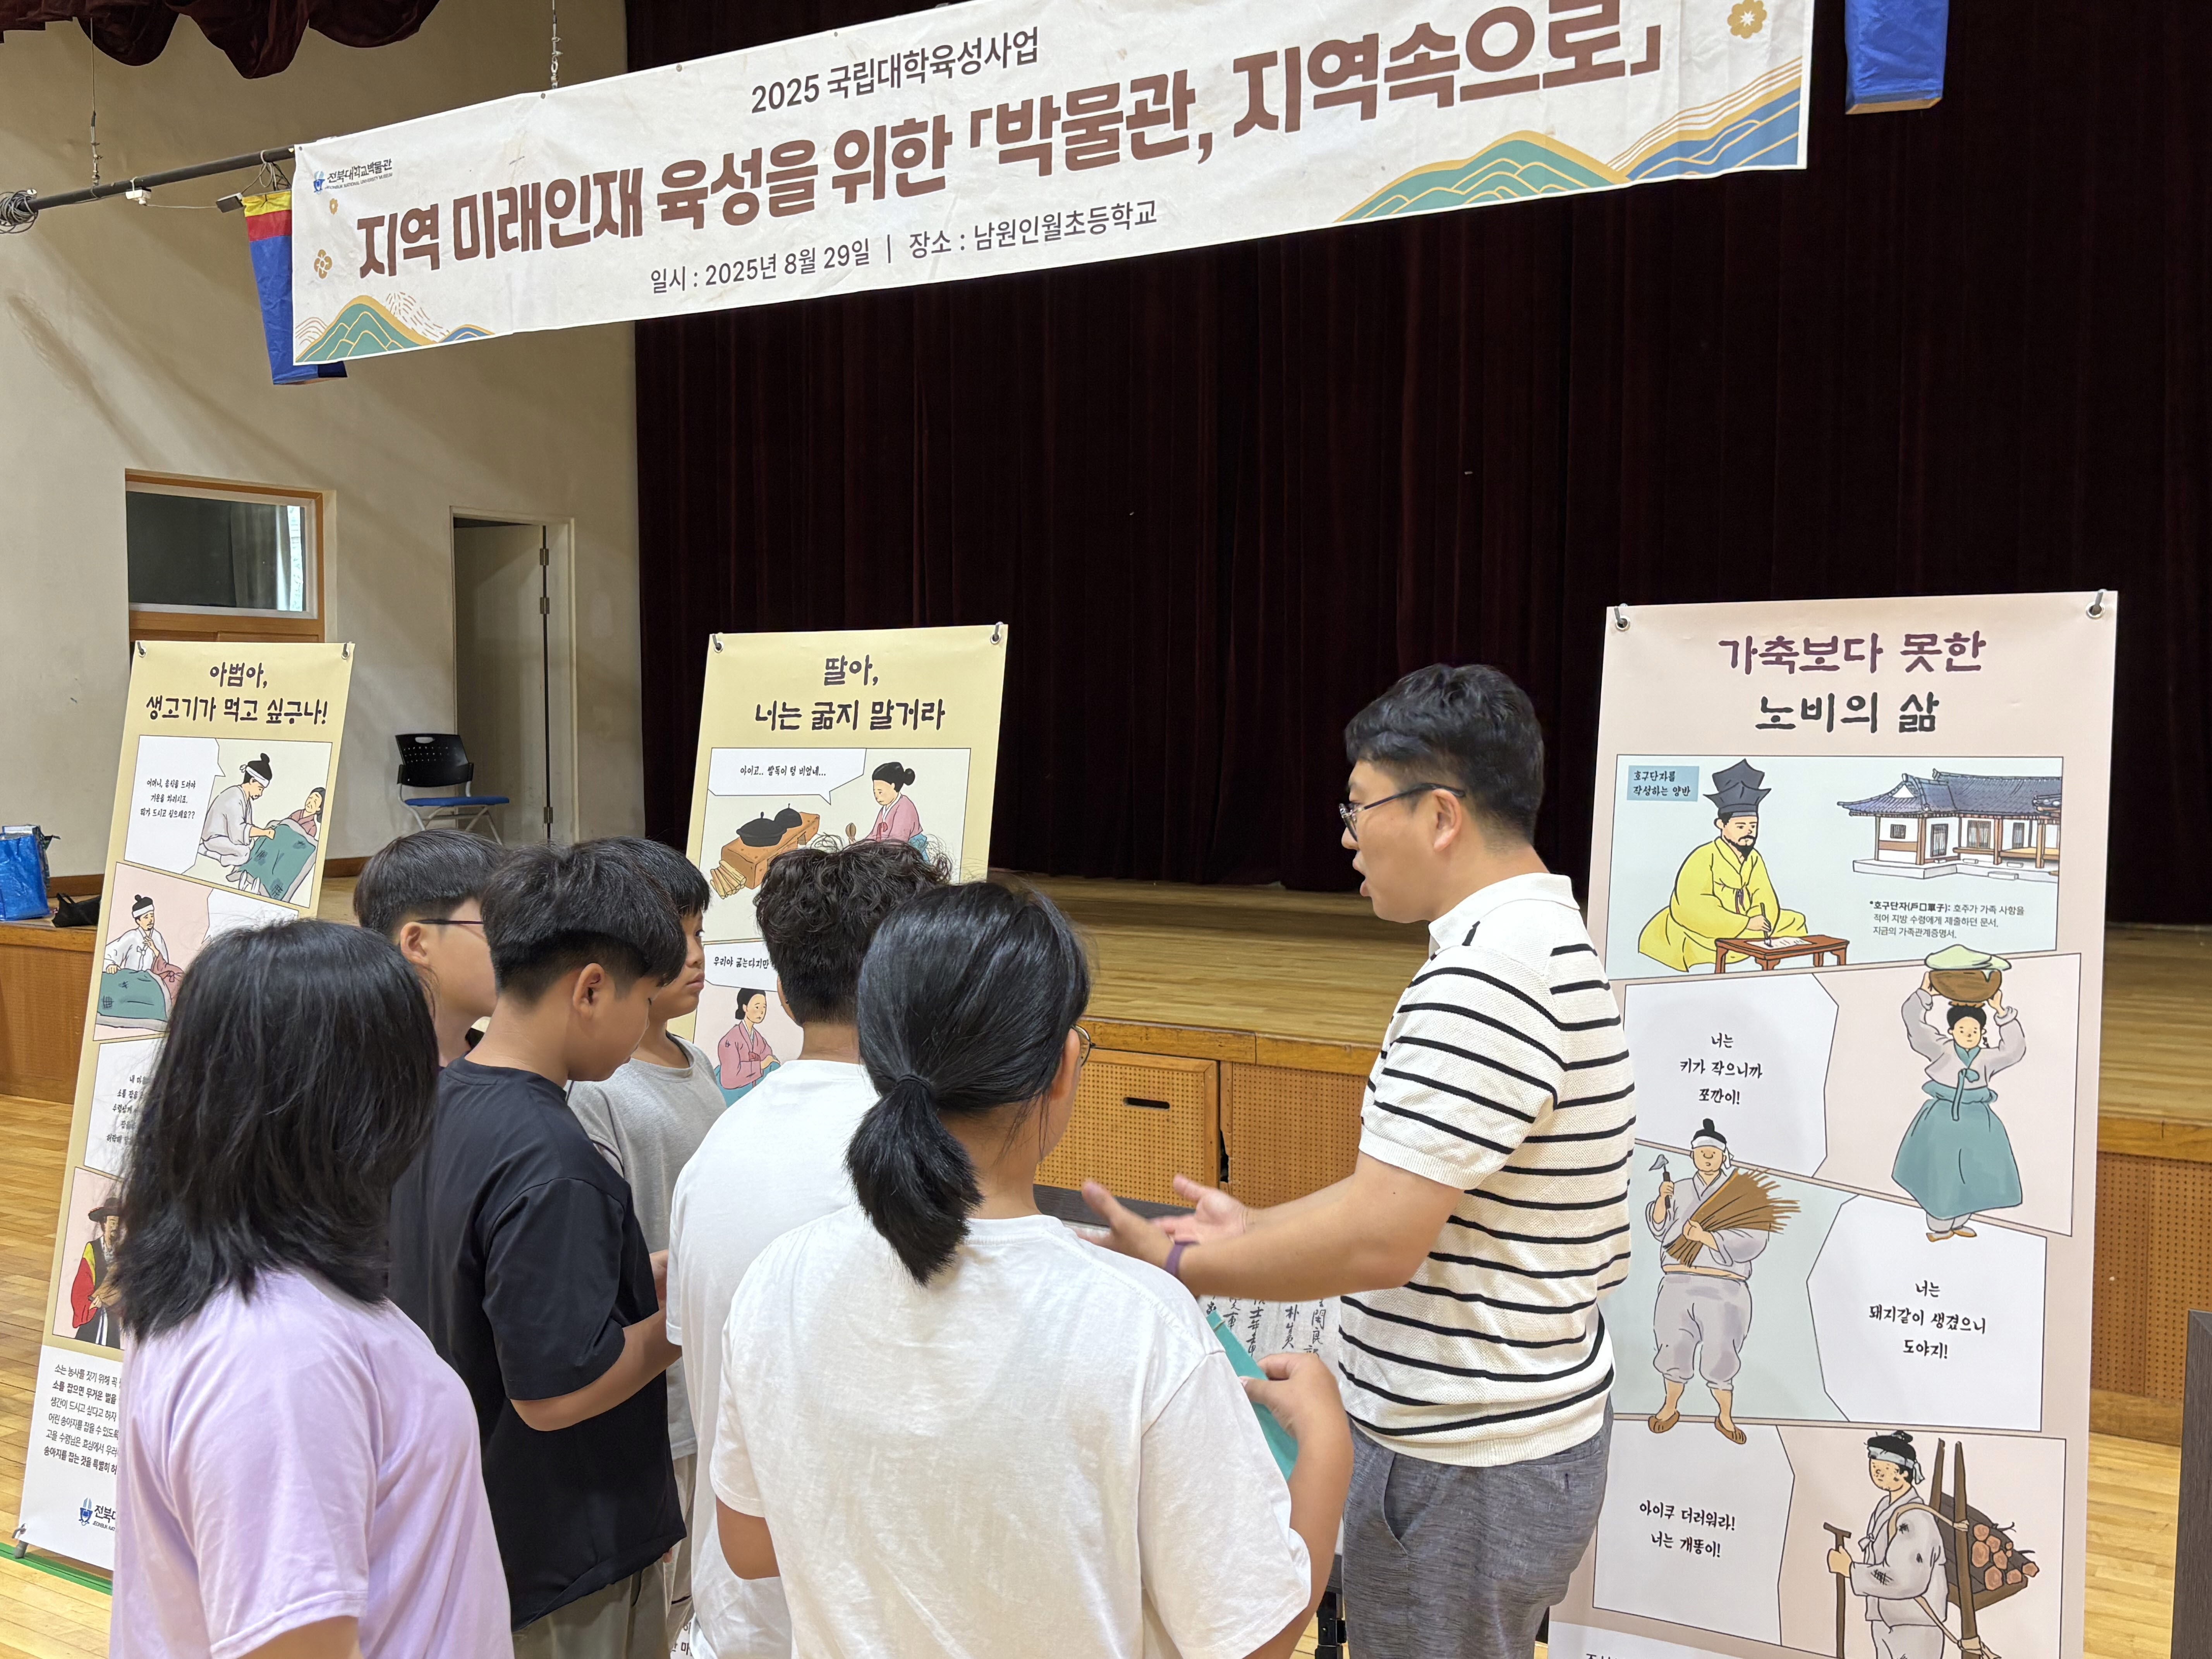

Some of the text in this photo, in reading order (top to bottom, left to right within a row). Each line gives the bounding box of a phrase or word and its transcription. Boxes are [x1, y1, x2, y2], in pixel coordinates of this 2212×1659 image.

[752, 26, 1037, 113] 2025 국립대학육성사업
[327, 158, 393, 184] 전북대학교박물관
[357, 203, 440, 279] 지역
[453, 167, 643, 261] 미래인재
[657, 139, 818, 230] 육성을
[832, 114, 953, 204] 위한
[651, 266, 685, 294] 일시
[706, 253, 776, 286] 2025년
[784, 247, 816, 275] 8월
[824, 238, 869, 269] 29일
[909, 230, 951, 259] 장소
[974, 200, 1157, 251] 남원인월초등학교
[1718, 630, 1987, 675] 가축보다 못한
[210, 661, 268, 689] 아범아,
[824, 654, 878, 686] 딸아,
[146, 695, 328, 725] 생고기가 먹고 싶구나!
[755, 699, 946, 731] 너는 굶지 말거라
[1755, 691, 1940, 733] 노비의 삶
[740, 765, 826, 776] 아이고.. 쌀독이 텅 비었네...
[1633, 770, 1675, 782] 호구단자를
[165, 779, 179, 789] 음식을
[1633, 785, 1691, 797] 작성하는 양반
[151, 793, 165, 803] 기운을
[140, 807, 151, 817] 뭐가
[152, 809, 167, 817] 드시고
[1874, 914, 1999, 927] 적어 지방 수령에게 제출하던 문서.
[1953, 904, 1978, 914] 호주가
[1980, 905, 1997, 915] 가족
[1999, 906, 2025, 915] 사항을
[1873, 926, 1957, 939] 지금의 가족관계증명서.
[713, 956, 769, 969] 우리야 굶는다지만
[1711, 1032, 1733, 1048] 너는
[1680, 1059, 1763, 1079] 키가 작으니까
[1699, 1088, 1740, 1105] 쪼깐이!
[1915, 1280, 1940, 1298] 너는
[1869, 1304, 1985, 1334] 돼지같이 생겼으니
[1903, 1340, 1948, 1359] 도야지!
[54, 1364, 67, 1375] 소는
[67, 1366, 85, 1380] 농사를
[86, 1371, 98, 1382] 짓기
[52, 1380, 117, 1405] 소를 잡으면 무거운 벌을
[50, 1397, 117, 1422] 생간이 드시고 싶다고 하자
[48, 1413, 119, 1441] 어린 송아지를 잡을 수 있도록
[45, 1429, 118, 1457] 고을 수령님은 효심에서 우러
[44, 1446, 67, 1461] 송아지를
[68, 1452, 80, 1464] 잡는
[81, 1456, 92, 1468] 것을
[93, 1459, 110, 1473] 특별히
[1639, 1500, 1735, 1531] 아이쿠 더러워라!
[1651, 1531, 1720, 1558] 너는 개똥이!
